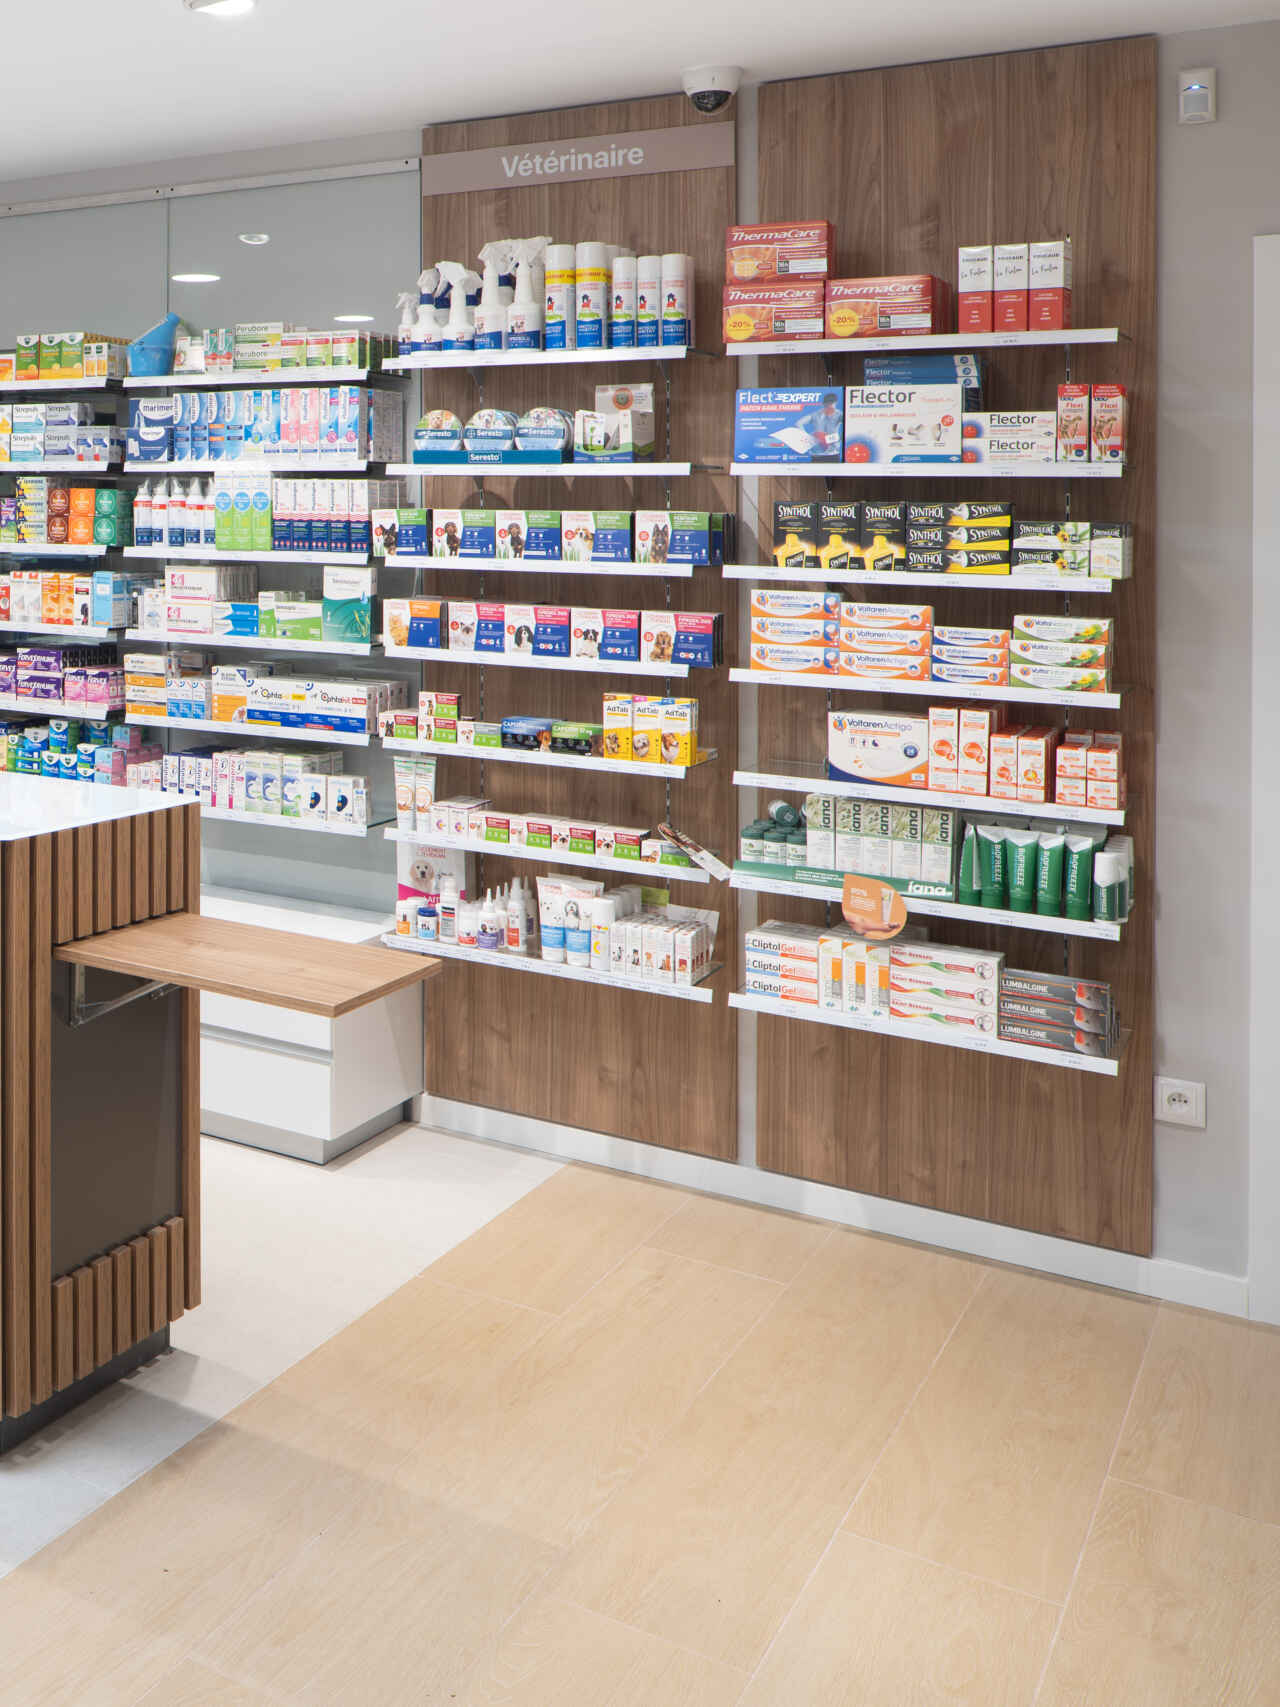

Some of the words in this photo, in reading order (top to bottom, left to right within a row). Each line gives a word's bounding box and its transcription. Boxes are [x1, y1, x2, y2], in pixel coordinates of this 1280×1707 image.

[502, 144, 645, 177] Vétérinaire
[732, 229, 820, 241] ThermaCare
[728, 289, 817, 301] ThermaCare
[830, 283, 924, 297] ThermaCare
[849, 389, 916, 404] Flector
[989, 414, 1037, 425] Flector
[989, 440, 1036, 450] Flector
[470, 452, 499, 461] Seresto
[778, 505, 811, 519] SYNTHOL
[822, 505, 856, 519] SYNTHOL
[865, 505, 900, 520] SYNTHOL
[910, 506, 944, 519] SYNTHOL
[909, 528, 943, 542] SYNTHOL
[908, 552, 943, 566] SYNTHOL
[606, 705, 629, 713] AdTab
[665, 709, 687, 717] AdTab
[821, 799, 831, 829] iana
[850, 803, 862, 832] iana
[878, 806, 889, 836] iana
[906, 809, 918, 840] iana
[936, 813, 950, 843] iana
[1001, 979, 1049, 993] LUMBALGINE
[1000, 1001, 1048, 1017] LUMBALGINE
[1000, 1024, 1048, 1039] LUMBALGINE
